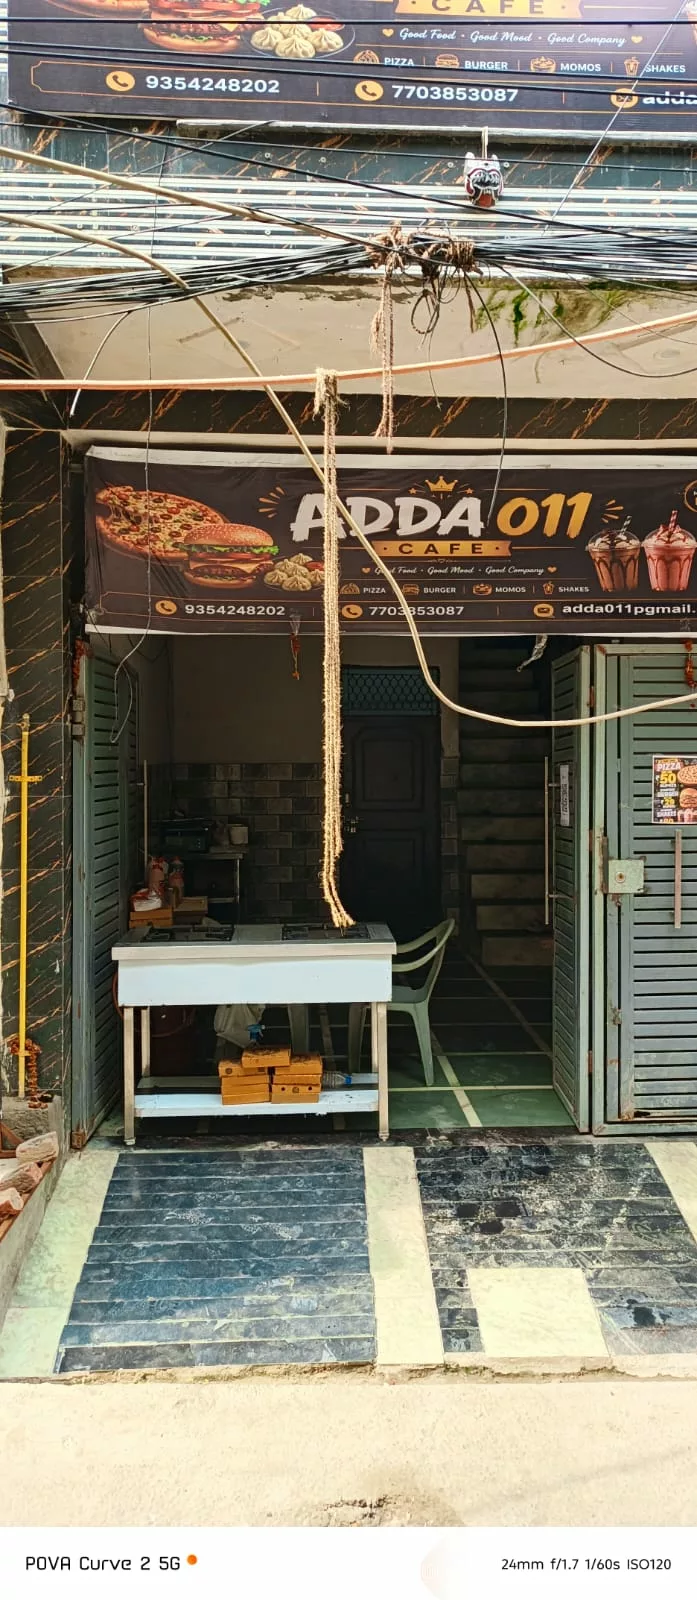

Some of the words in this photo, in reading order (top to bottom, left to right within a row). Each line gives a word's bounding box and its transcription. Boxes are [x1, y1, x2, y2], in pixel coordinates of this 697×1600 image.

[431, 0, 544, 14] CAFE
[399, 28, 427, 40] Good
[430, 29, 456, 40] Food
[470, 31, 498, 43] Good
[500, 31, 533, 42] Mood
[547, 33, 574, 45] Good
[577, 33, 626, 47] Company
[384, 57, 415, 66] PIZZA
[464, 60, 509, 70] BURGER
[560, 63, 602, 72] MOMOS
[645, 64, 686, 73] SHAKES
[145, 75, 280, 93] 9354248202
[391, 85, 518, 102] 7703853087
[290, 493, 485, 542] ADDA
[496, 492, 593, 539] 011
[398, 543, 483, 554] CAFE
[397, 566, 417, 574] Food
[427, 566, 448, 576] Good
[450, 566, 475, 574] Mood
[485, 566, 506, 576] Good
[508, 566, 544, 576] Company
[185, 604, 285, 616] 9354248202
[368, 606, 464, 616] 7703853087
[656, 763, 681, 772] PIZZA
